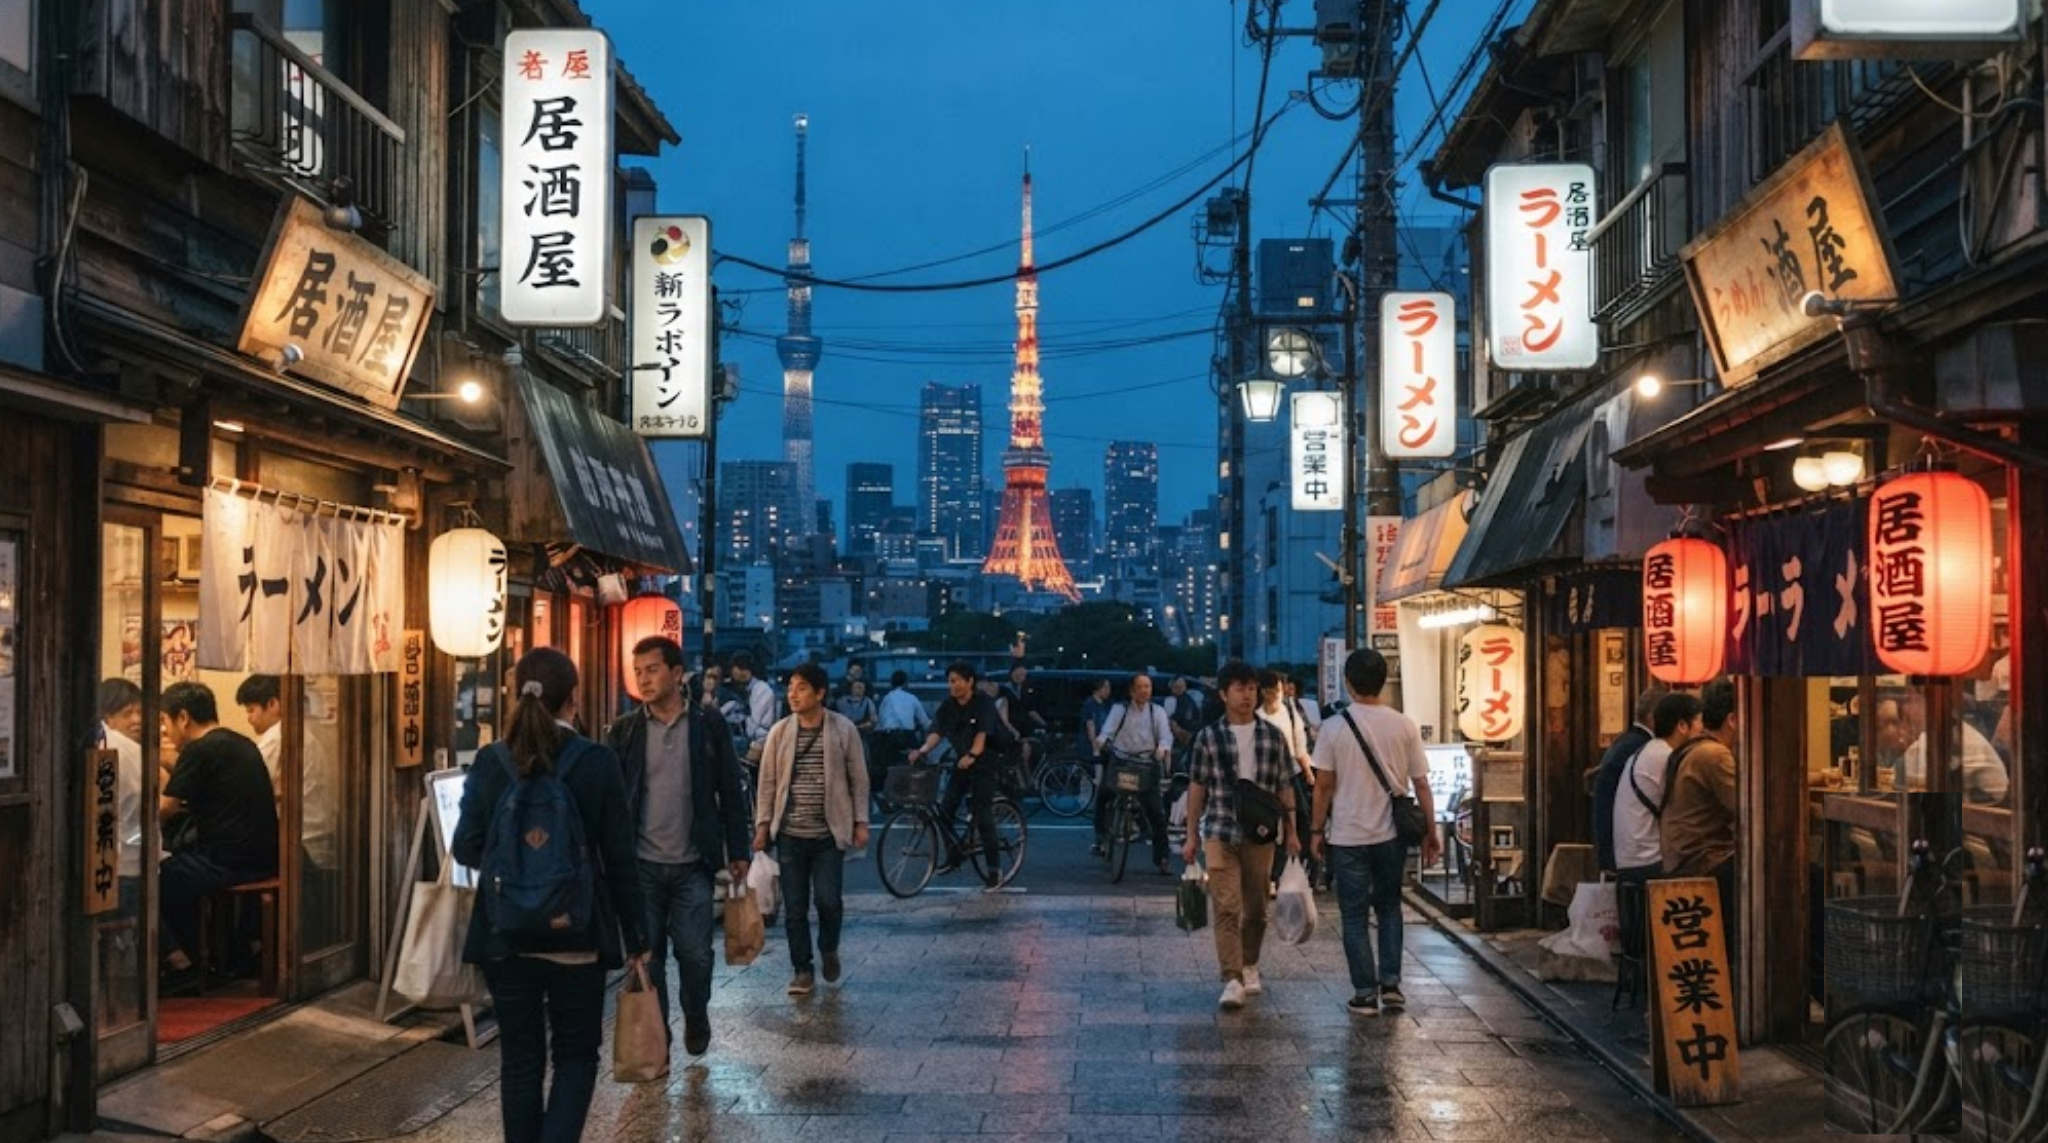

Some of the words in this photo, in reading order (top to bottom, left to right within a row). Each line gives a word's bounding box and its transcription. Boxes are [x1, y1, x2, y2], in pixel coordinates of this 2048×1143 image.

[518, 96, 583, 289] 居酒屋
[1566, 182, 1590, 251] 居酒屋
[274, 248, 410, 376] 居酒屋
[1519, 188, 1563, 352] ラーメン
[1397, 300, 1438, 448] ラーメン
[238, 546, 363, 627] ラーメン
[486, 548, 506, 643] ラーメン
[1647, 553, 1678, 667] 居酒屋
[1732, 548, 1869, 642] ラーラメ
[1875, 491, 1929, 652] 居酒屋
[1480, 636, 1515, 738] ラーメン
[1661, 896, 1729, 1082] 営業中
